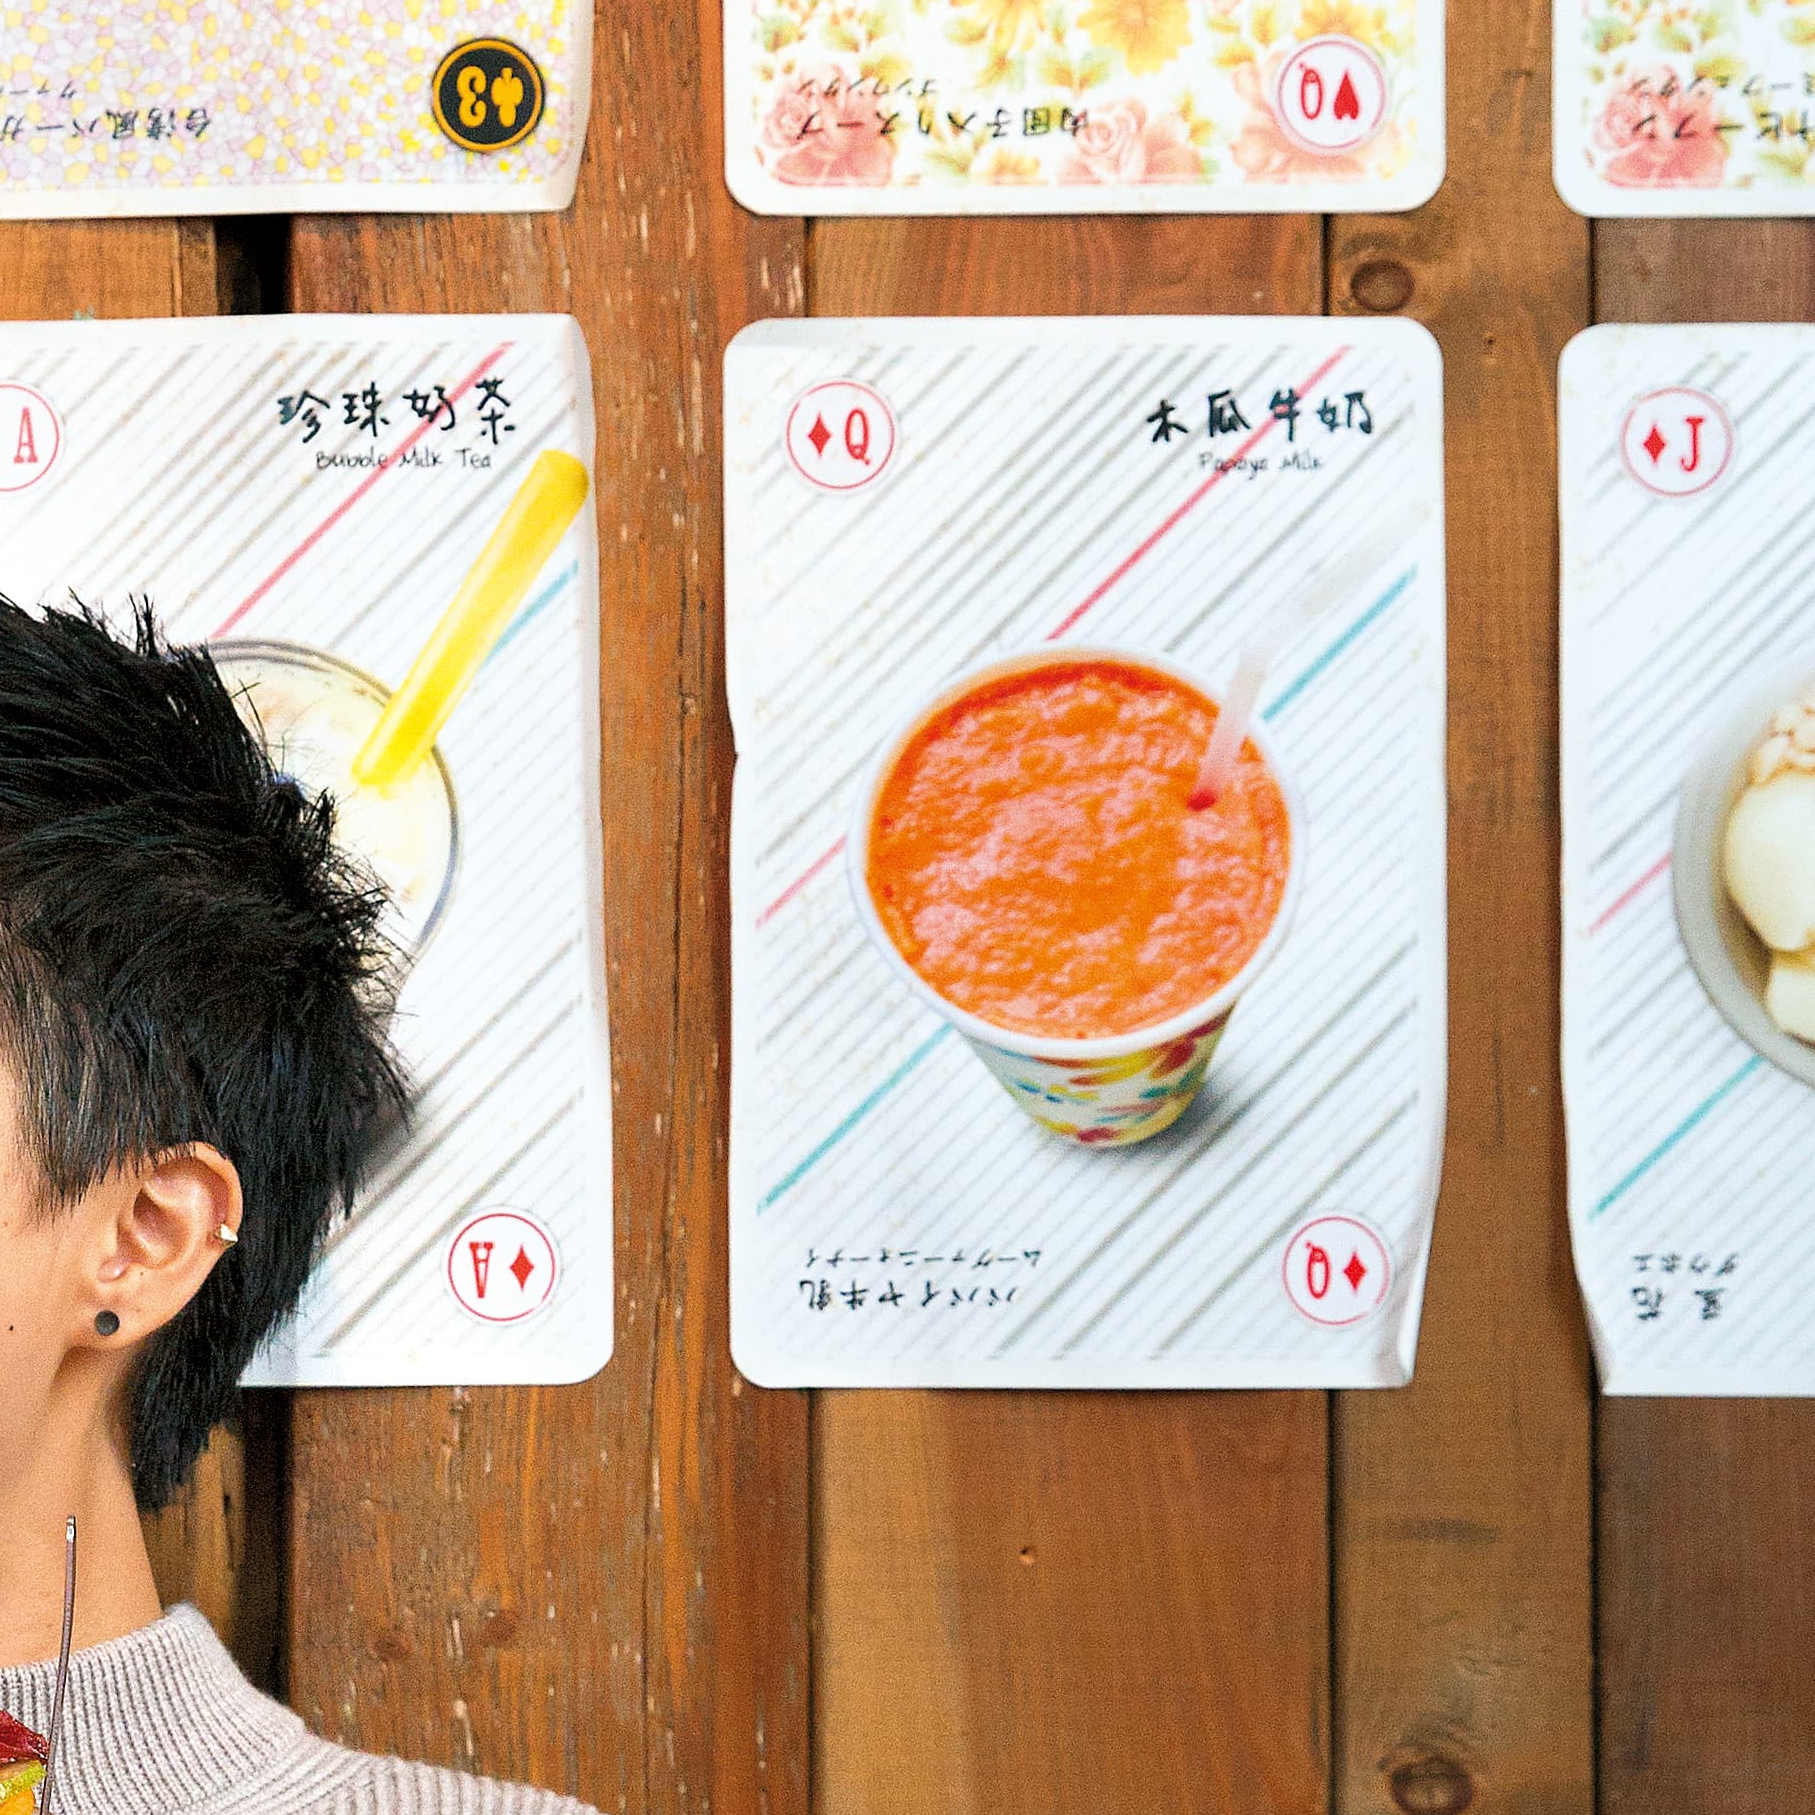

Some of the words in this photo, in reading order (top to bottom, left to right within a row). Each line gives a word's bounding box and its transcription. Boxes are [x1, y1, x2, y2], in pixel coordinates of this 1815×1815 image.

[457, 66, 487, 129] 3
[1299, 63, 1324, 121] Q
[794, 107, 1088, 141] 肉団子入りスープ
[13, 406, 38, 464] A
[277, 377, 516, 446] 珍珠奶茶
[844, 407, 870, 466] Q
[1146, 389, 1374, 444] 木瓜牛奶
[399, 446, 442, 468] Milk
[454, 447, 491, 469] Tea
[1279, 448, 1322, 471] Milk
[1680, 416, 1704, 473] J
[469, 1242, 495, 1300] A
[1306, 1241, 1331, 1300] Q
